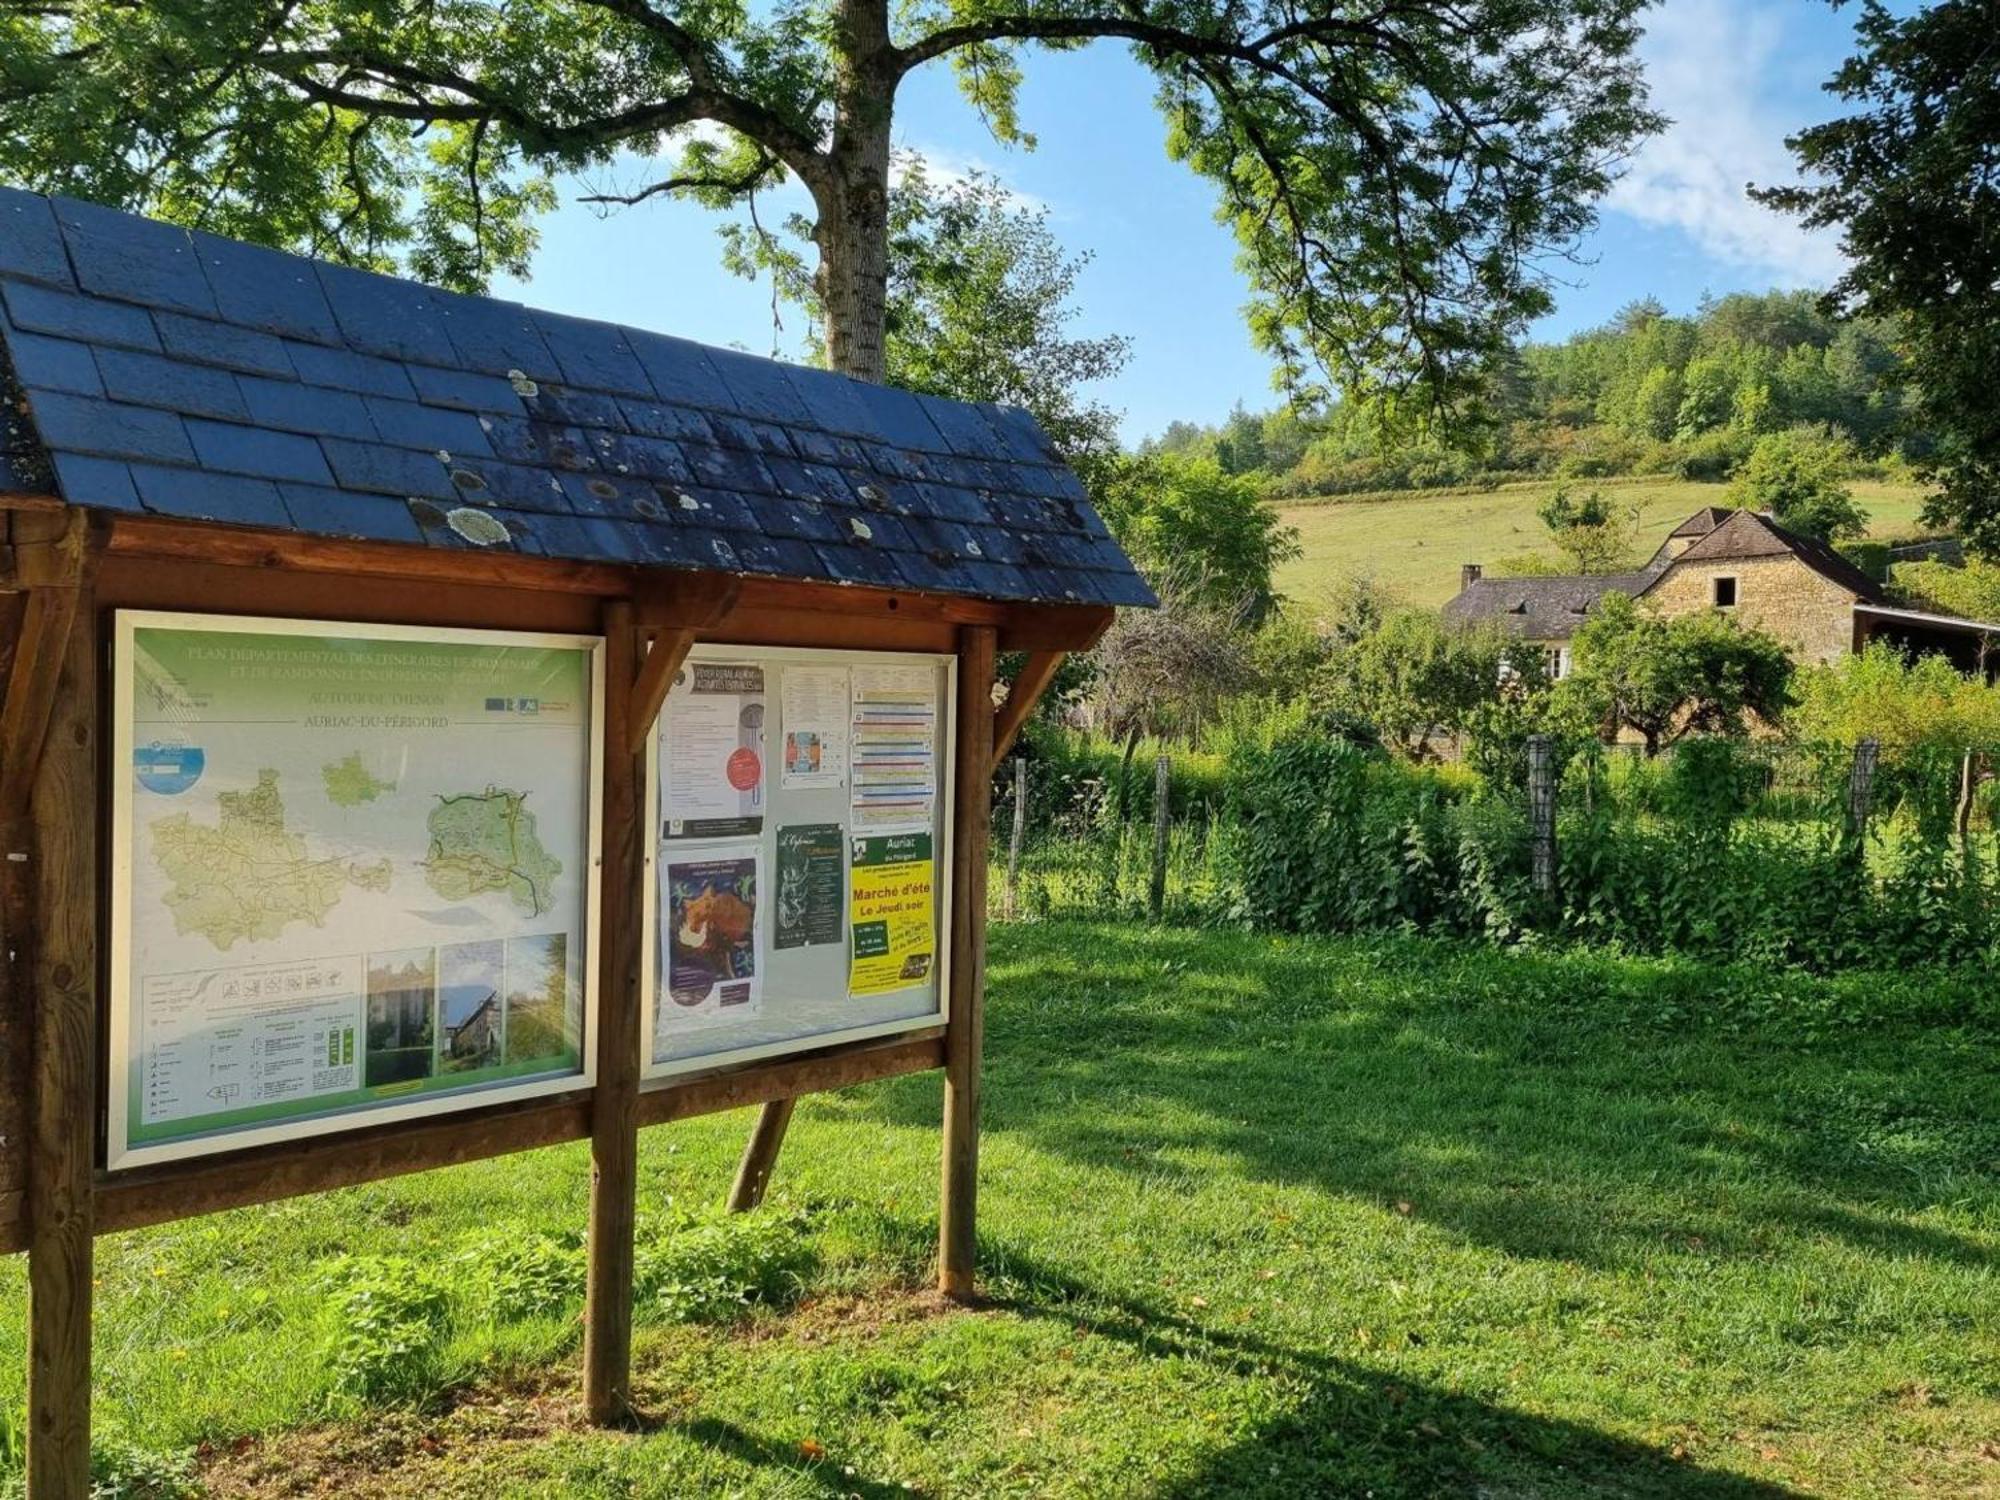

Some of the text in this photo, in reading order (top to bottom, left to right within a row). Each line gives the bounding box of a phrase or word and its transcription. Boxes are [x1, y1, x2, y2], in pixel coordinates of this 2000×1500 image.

[187, 647, 226, 661] PLAN
[309, 691, 370, 705] AUTOUR
[304, 713, 450, 728] AURIAC-DU-PÉRIGORD
[886, 837, 916, 850] Auriac
[894, 852, 917, 862] Périgord
[853, 882, 931, 902] Marché d'été
[860, 900, 924, 917] Le Jeudi soir
